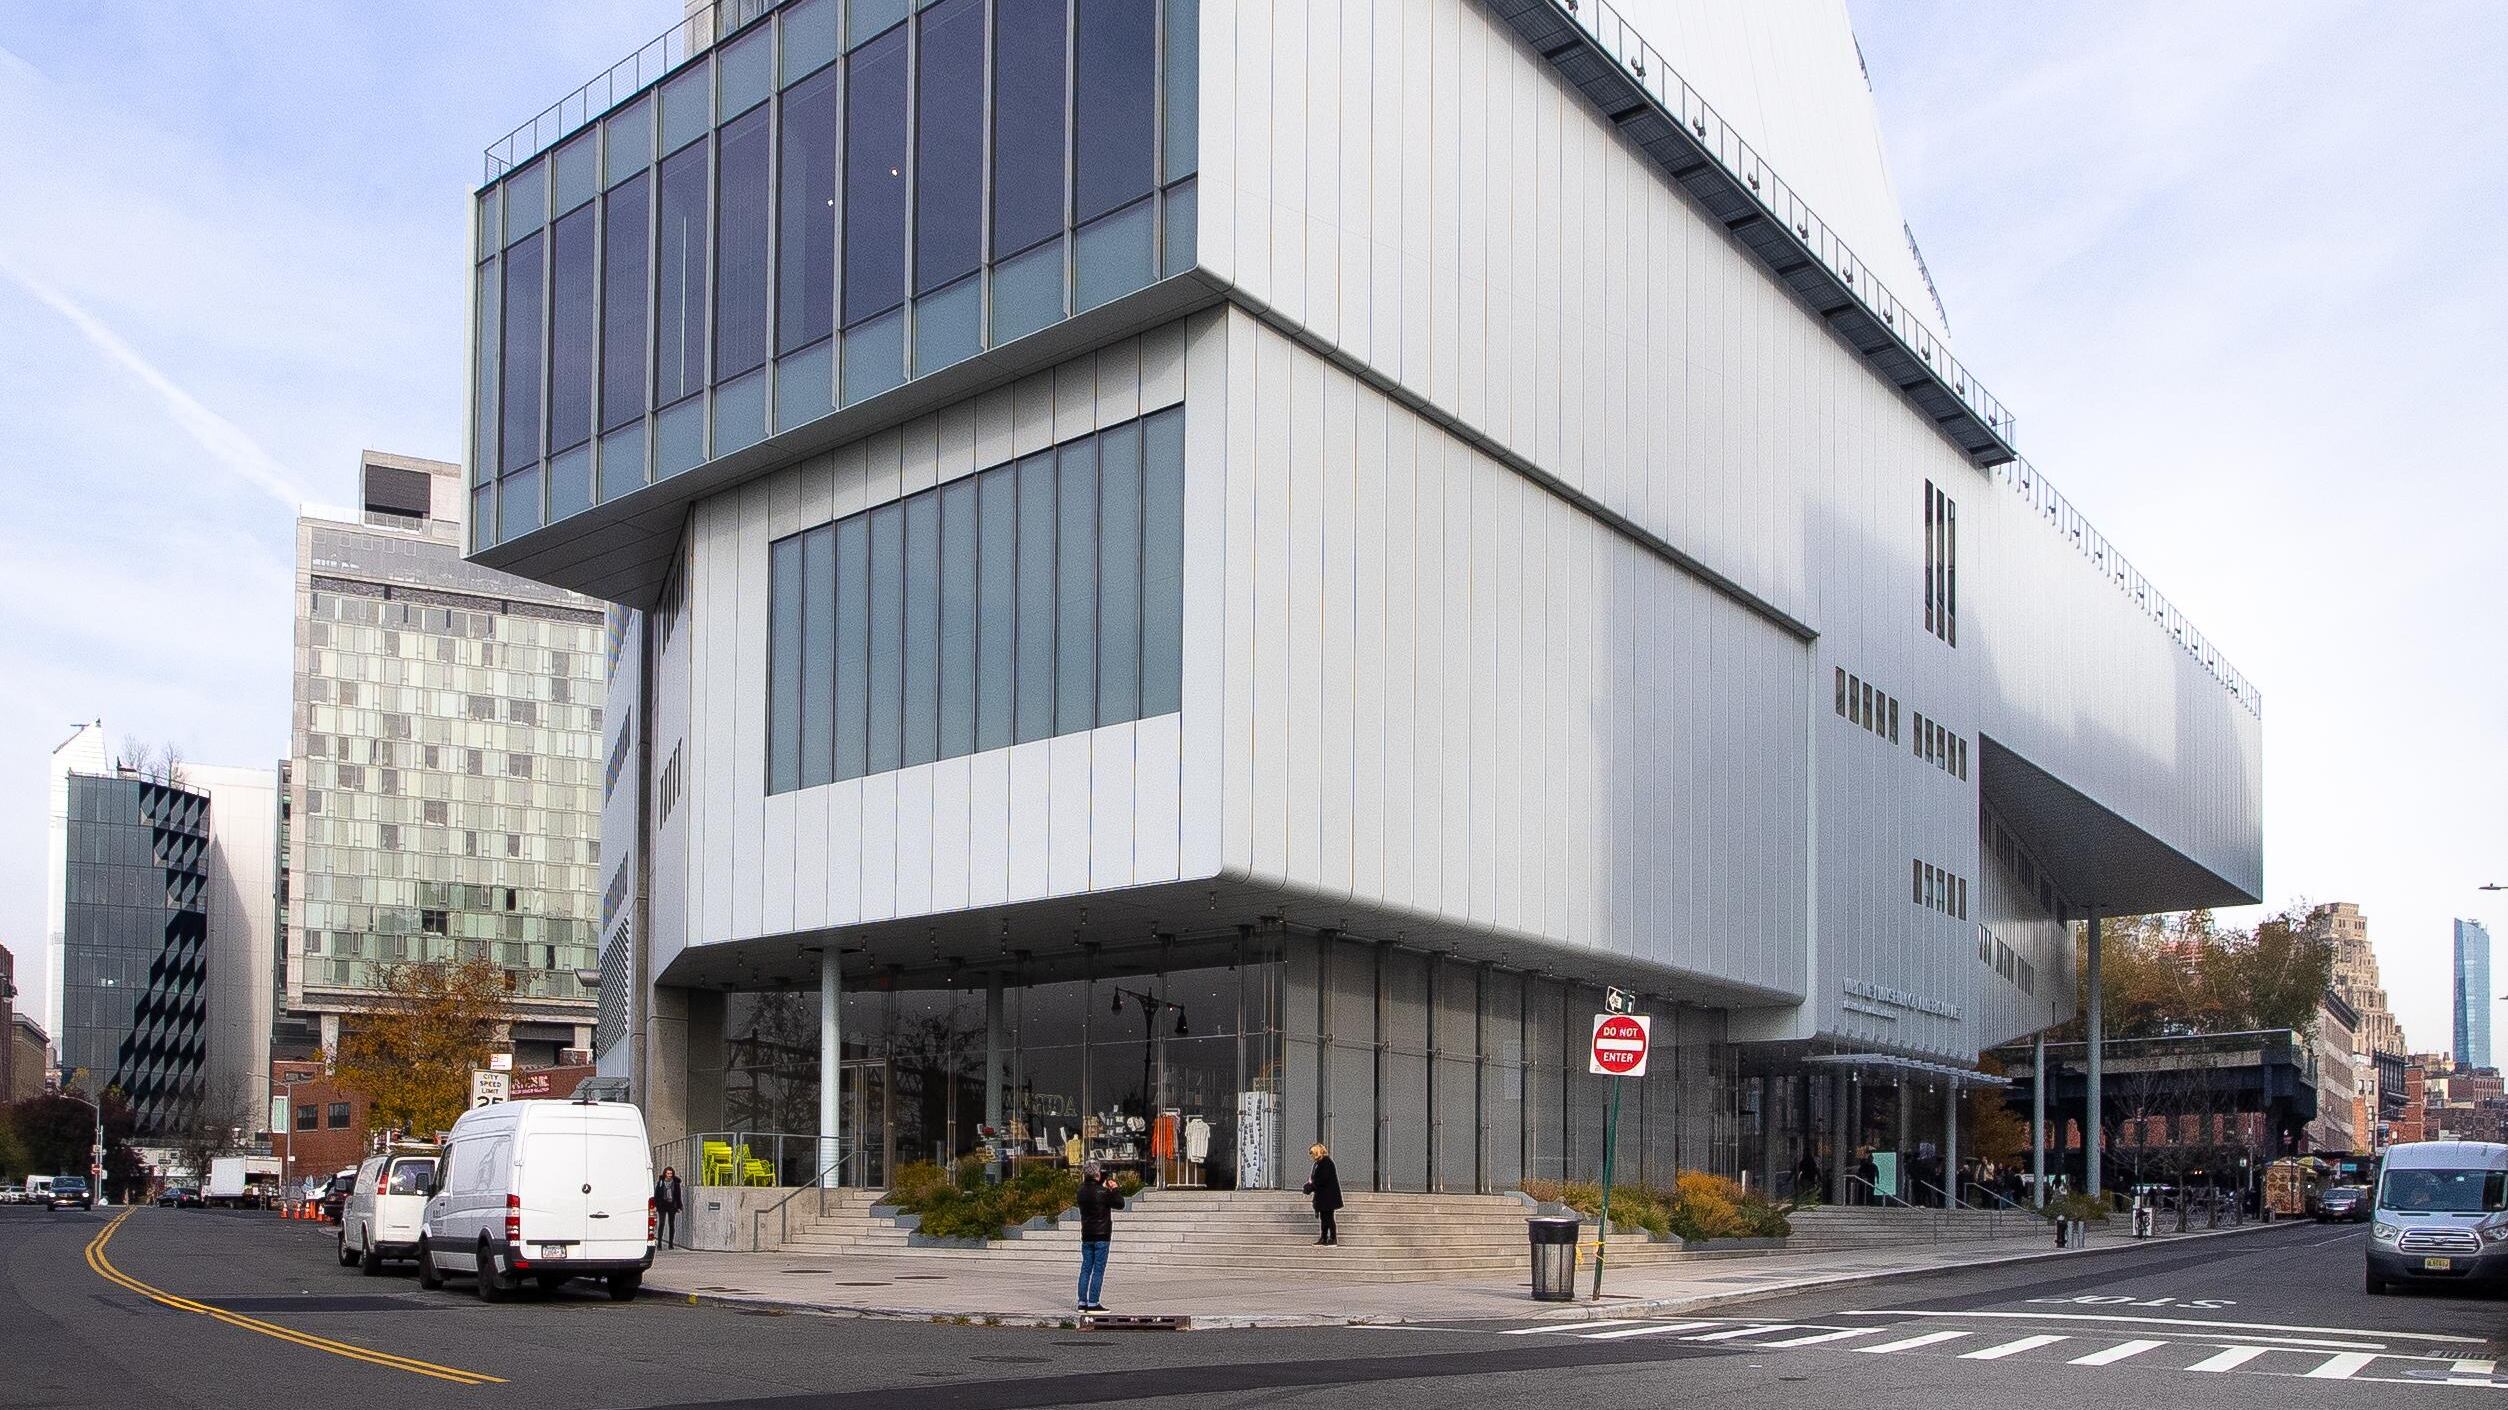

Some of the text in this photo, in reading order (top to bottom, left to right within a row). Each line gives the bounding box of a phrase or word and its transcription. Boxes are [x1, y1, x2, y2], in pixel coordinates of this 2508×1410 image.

[1603, 1027, 1638, 1037] DO NOT
[1603, 1052, 1633, 1062] ENTER
[2026, 1295, 2236, 1308] STOP
